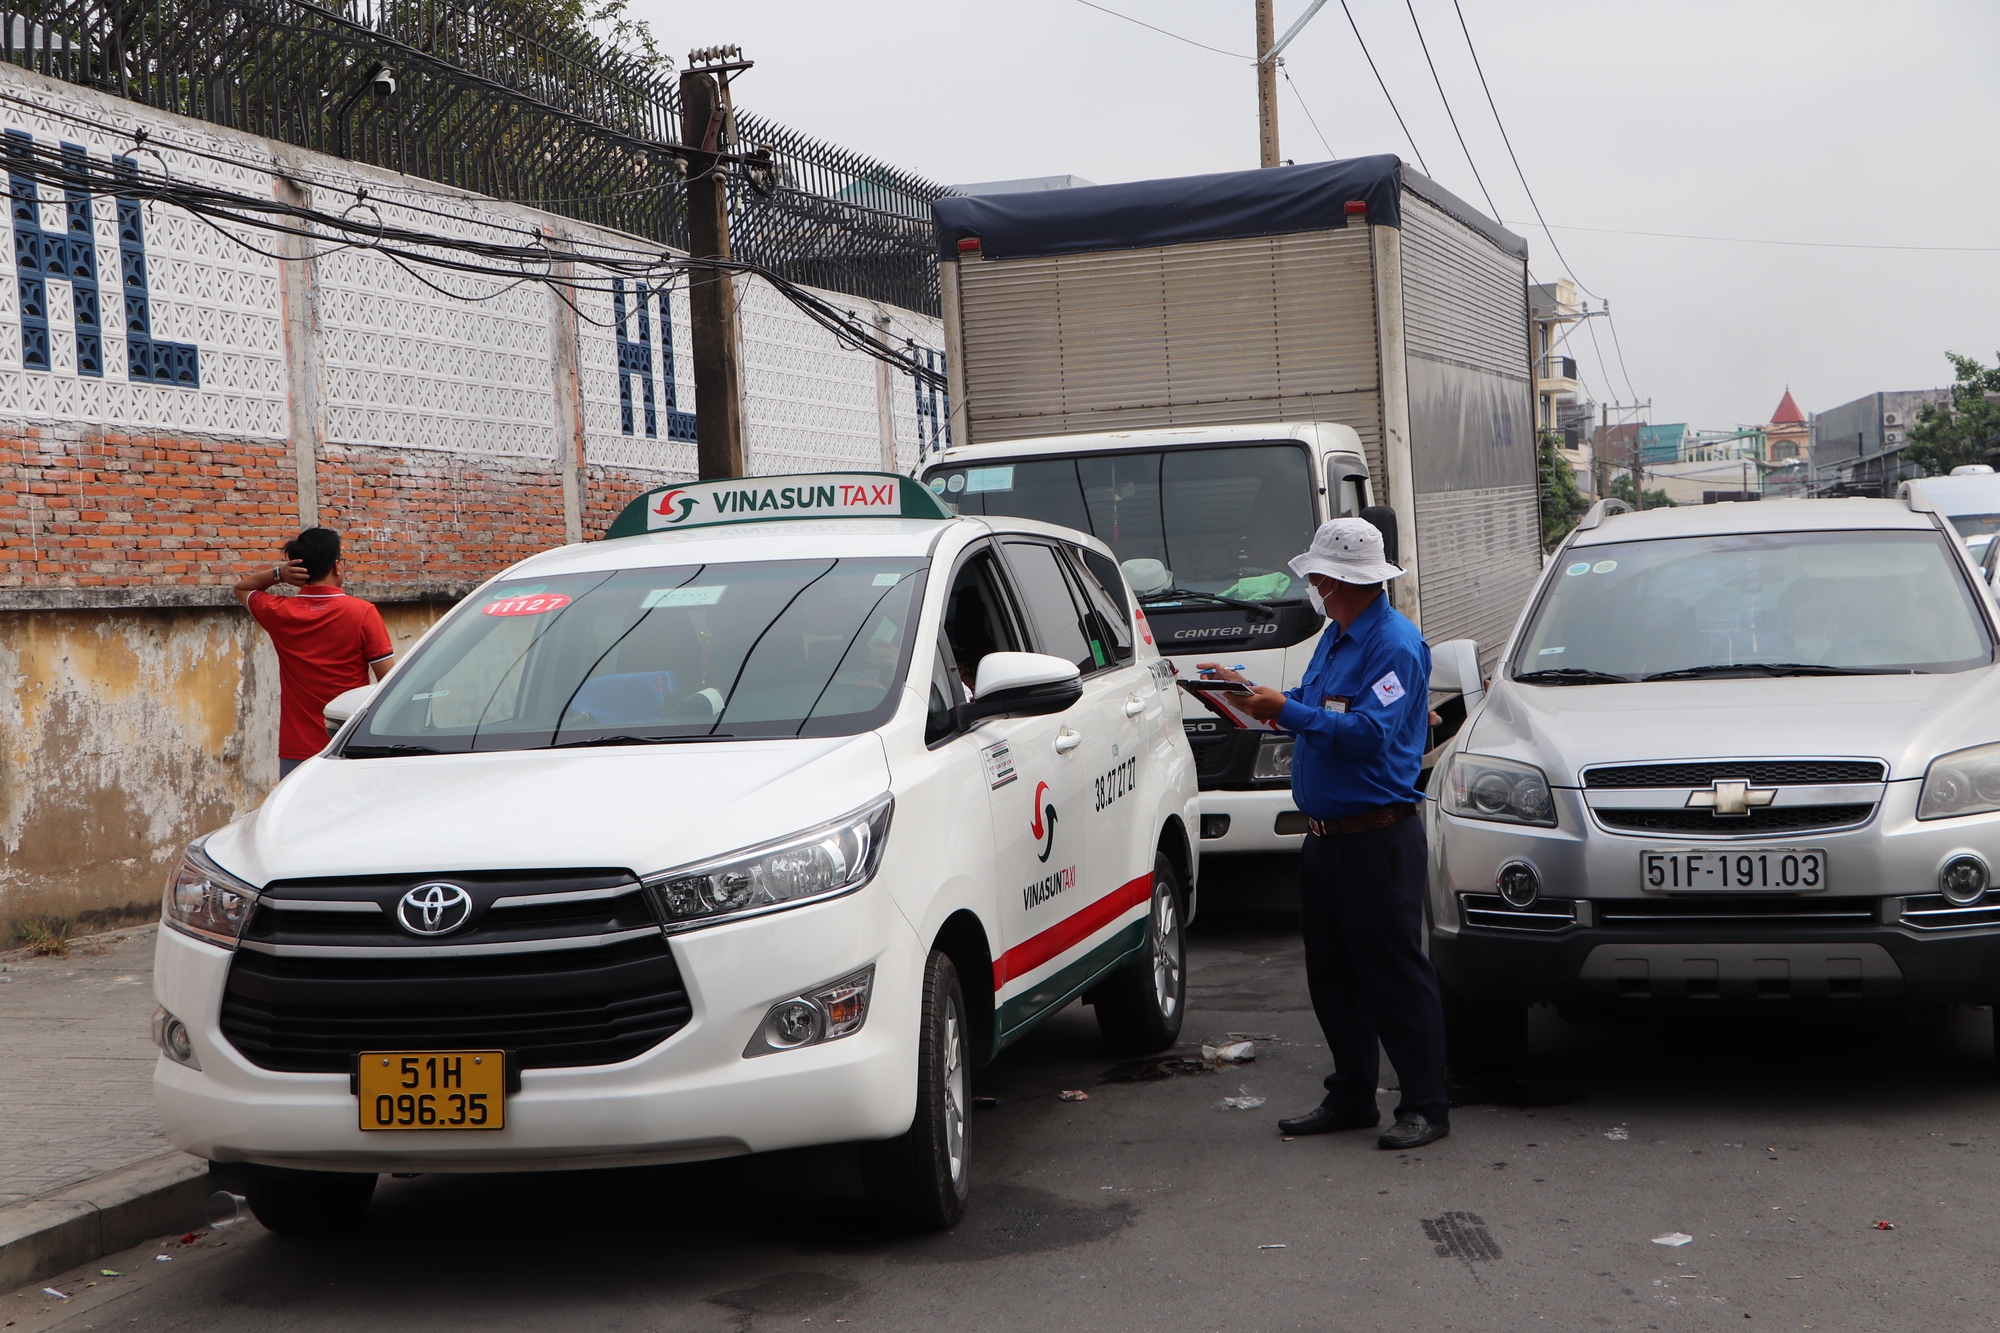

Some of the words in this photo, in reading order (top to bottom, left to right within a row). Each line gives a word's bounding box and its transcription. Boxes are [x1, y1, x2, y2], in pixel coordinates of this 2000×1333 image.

[487, 597, 564, 614] 11127
[1174, 626, 1244, 639] CANTER
[1248, 623, 1279, 635] HD
[1647, 854, 1820, 887] 51F-191.03
[400, 1056, 463, 1089] 51H
[375, 1093, 488, 1126] 096.35
